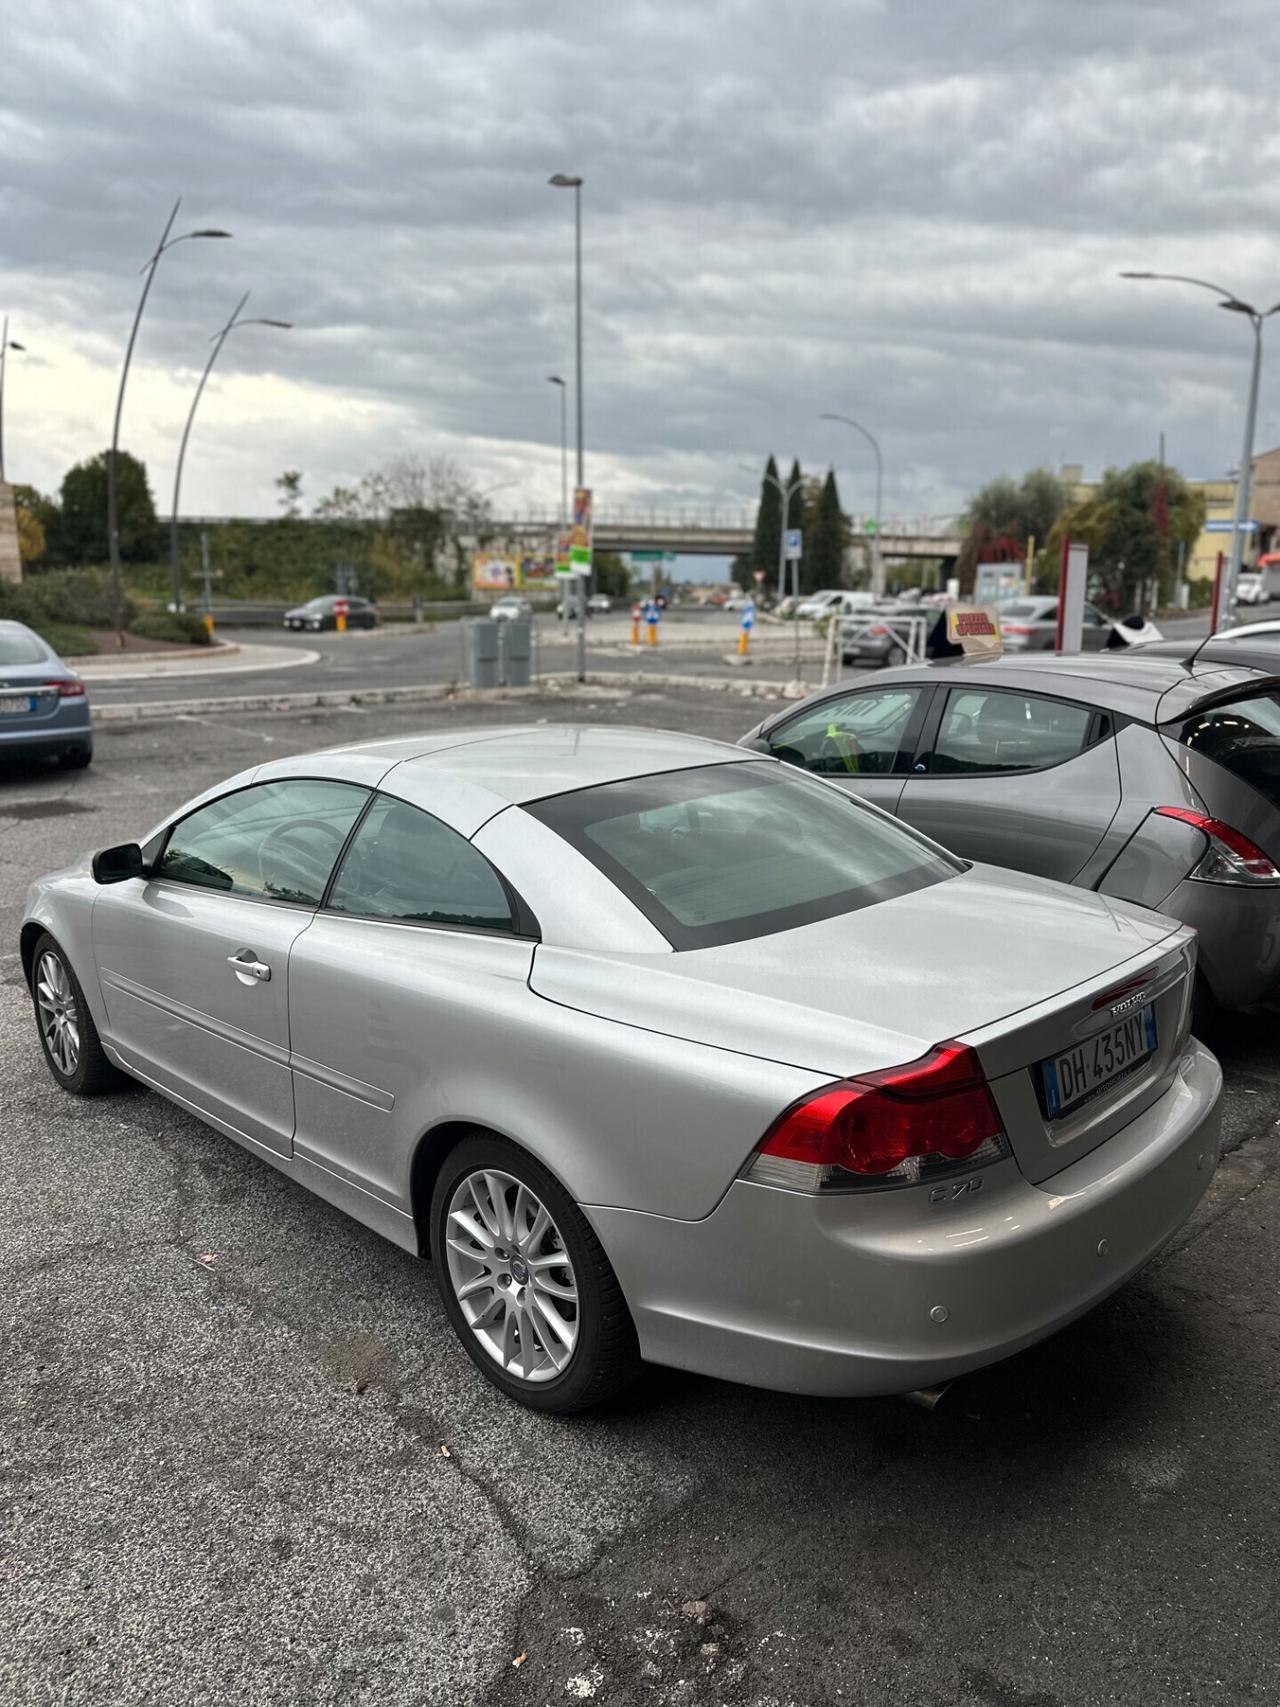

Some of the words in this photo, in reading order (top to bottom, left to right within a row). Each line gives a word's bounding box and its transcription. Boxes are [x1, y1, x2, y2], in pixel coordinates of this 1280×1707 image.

[1060, 1048, 1086, 1101] DH
[1093, 1011, 1143, 1079] 435NY
[929, 1176, 984, 1203] C70
